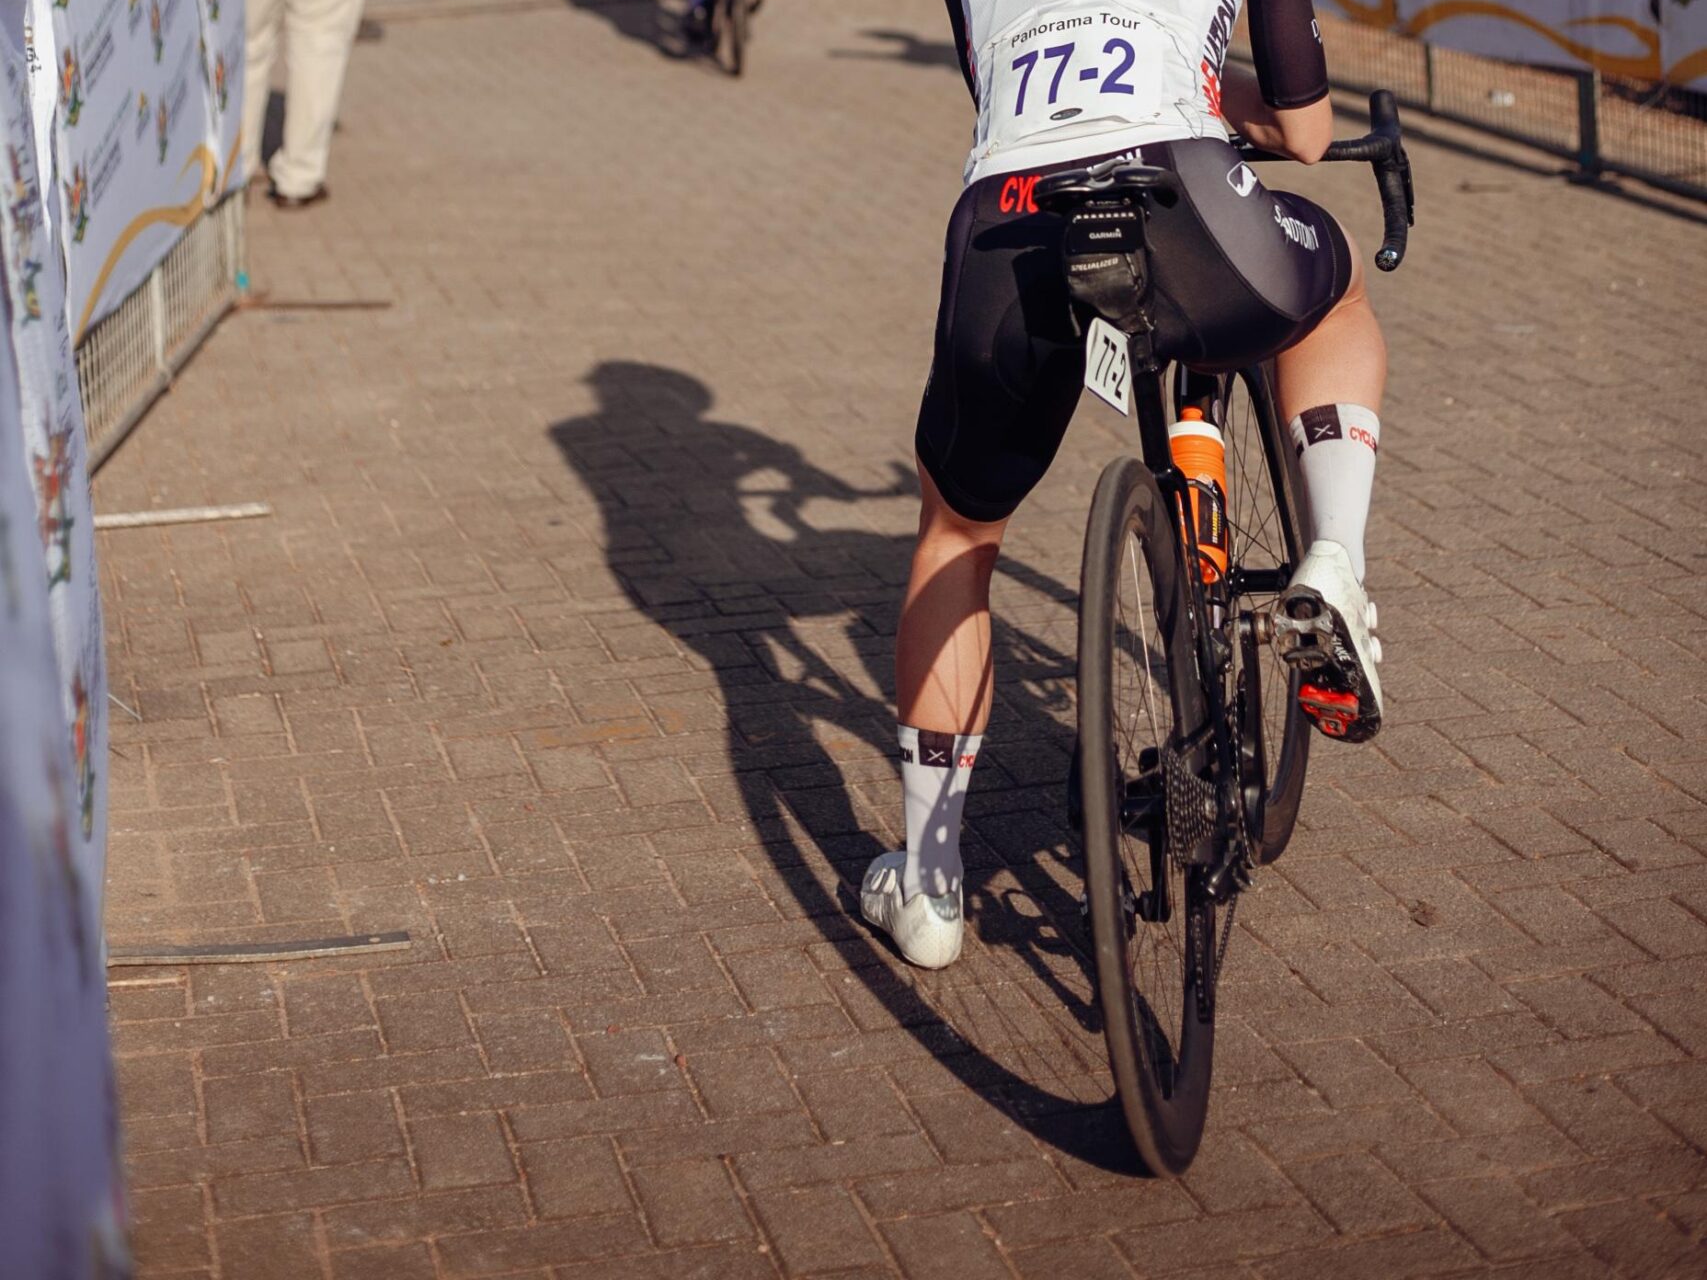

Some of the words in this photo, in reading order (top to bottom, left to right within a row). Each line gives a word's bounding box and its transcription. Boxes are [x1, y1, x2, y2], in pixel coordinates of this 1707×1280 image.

[1011, 15, 1093, 48] Panorama
[1100, 12, 1141, 30] Tour
[1012, 37, 1136, 117] 77-2
[1089, 228, 1122, 239] GARMIN
[1095, 334, 1127, 400] 77-2
